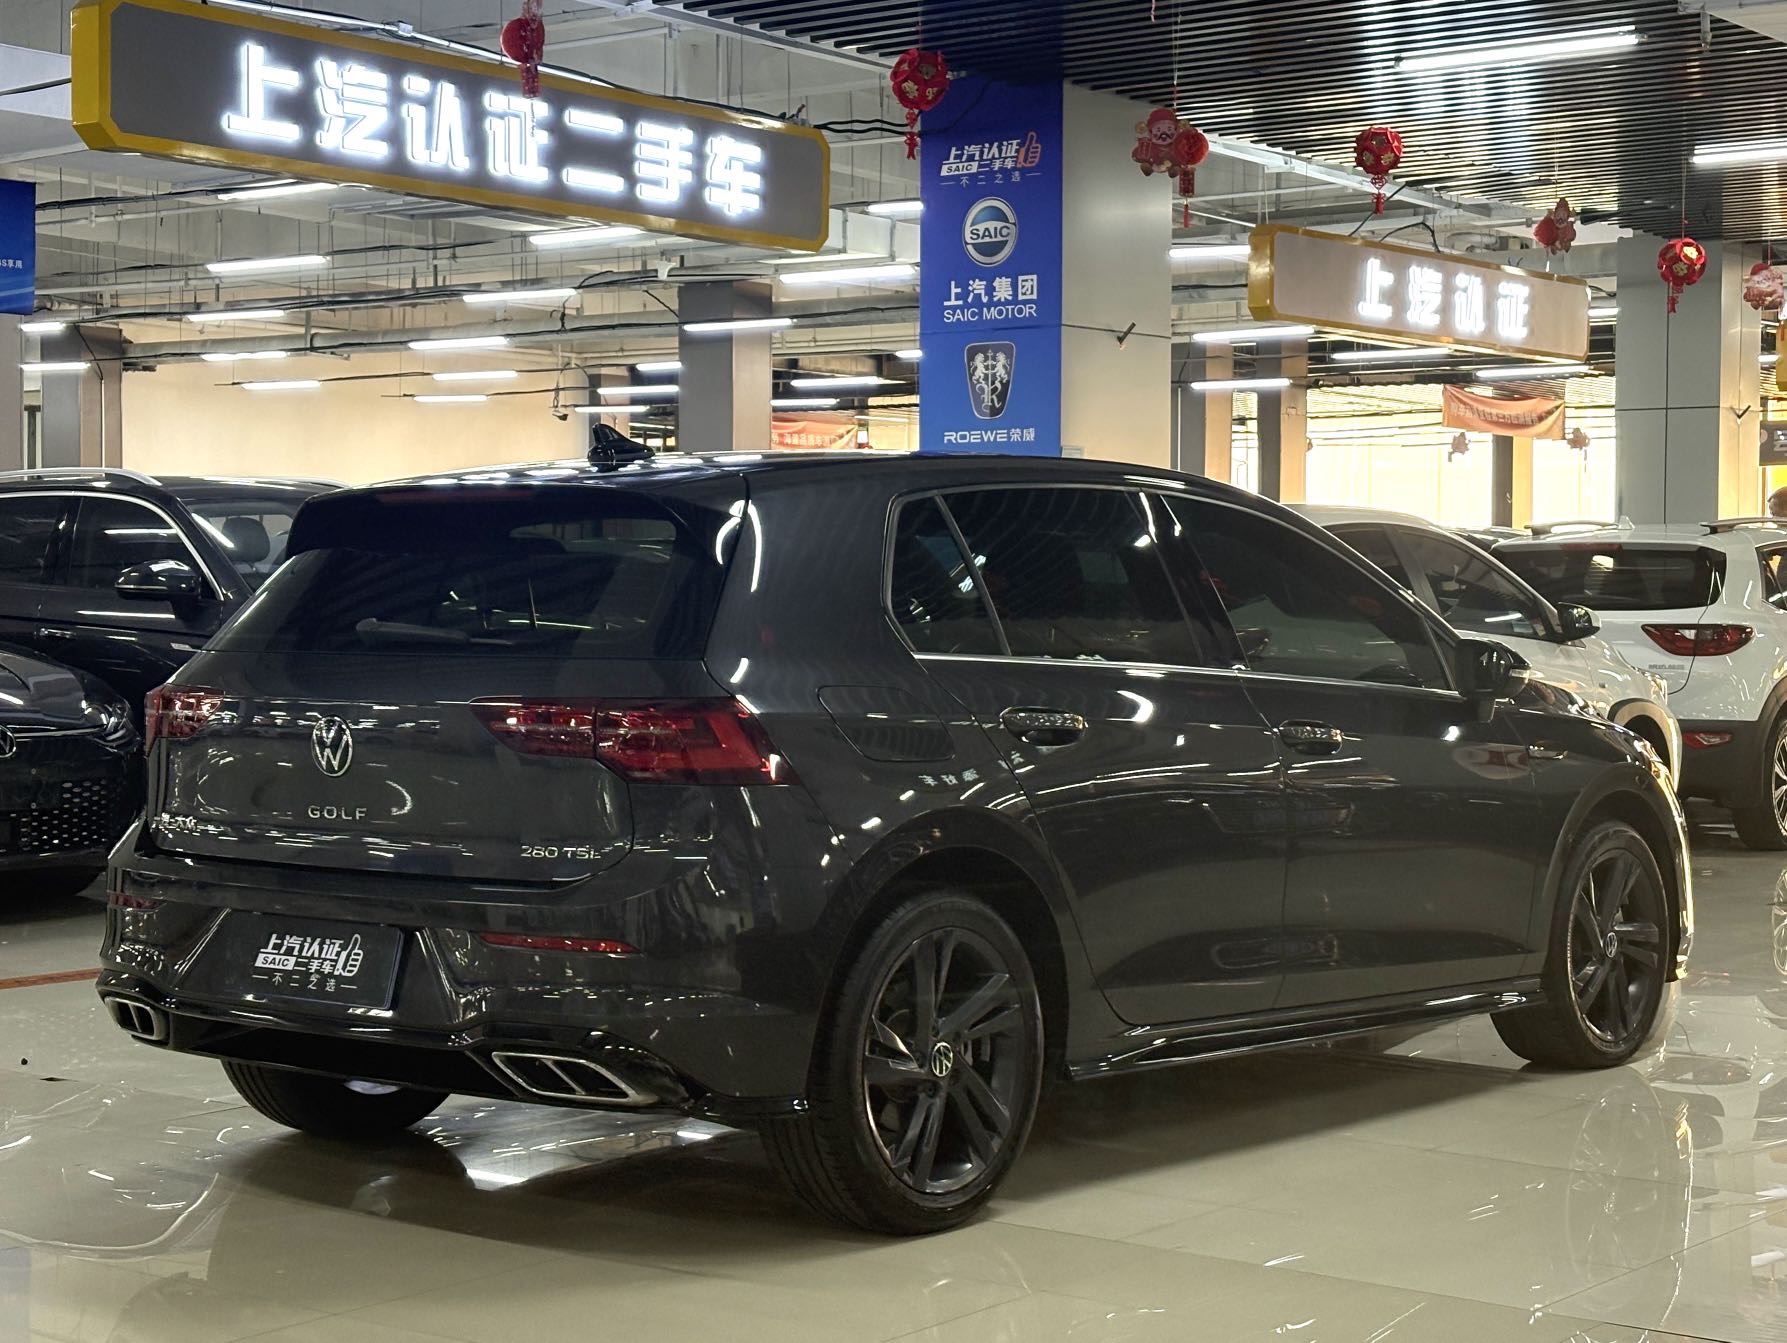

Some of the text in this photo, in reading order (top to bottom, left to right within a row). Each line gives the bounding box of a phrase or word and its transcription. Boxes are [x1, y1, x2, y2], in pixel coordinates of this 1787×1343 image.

[222, 42, 762, 215] 上汽认证二手车
[943, 140, 1020, 163] 上汽认证
[946, 164, 973, 173] SAIC
[978, 158, 1016, 171] 二手车
[970, 225, 1010, 241] SAIC
[943, 274, 1038, 306] 上汽集团
[1358, 257, 1530, 339] 上汽认证
[943, 304, 1037, 323] SAIC MOTOR
[308, 805, 367, 820] GOLF
[521, 845, 558, 858] 280
[260, 934, 344, 959] 上汽认证
[261, 955, 290, 967] SAIC
[293, 958, 336, 974] 二手车
[272, 972, 336, 991] 不二之选
